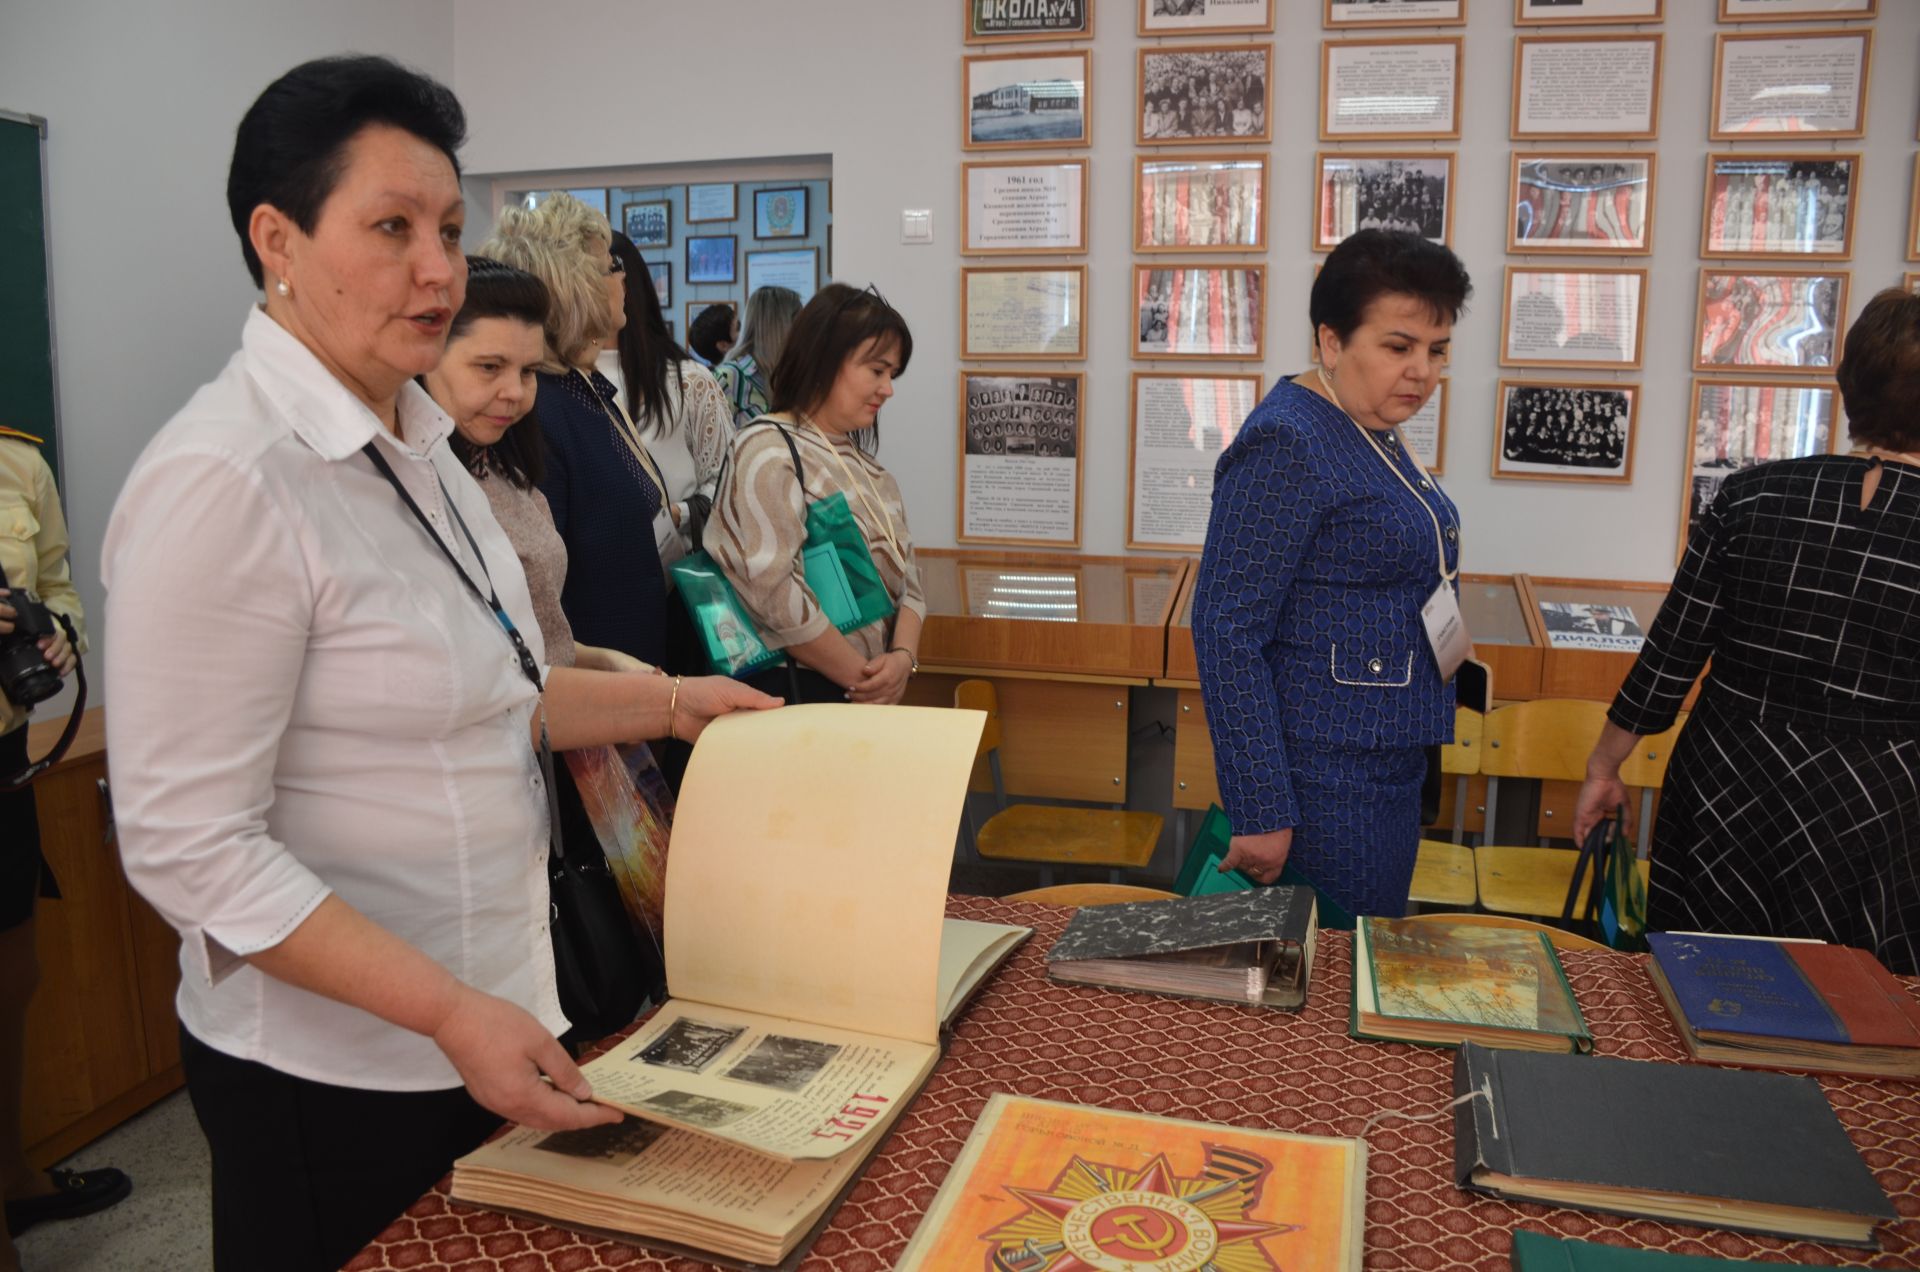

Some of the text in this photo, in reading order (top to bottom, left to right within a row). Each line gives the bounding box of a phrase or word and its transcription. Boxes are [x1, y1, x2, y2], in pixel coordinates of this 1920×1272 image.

[982, 0, 1048, 18] ШКОЛА
[1007, 176, 1026, 185] 1961
[1553, 633, 1643, 646] ДИАЛОГ
[810, 1092, 890, 1143] 1925
